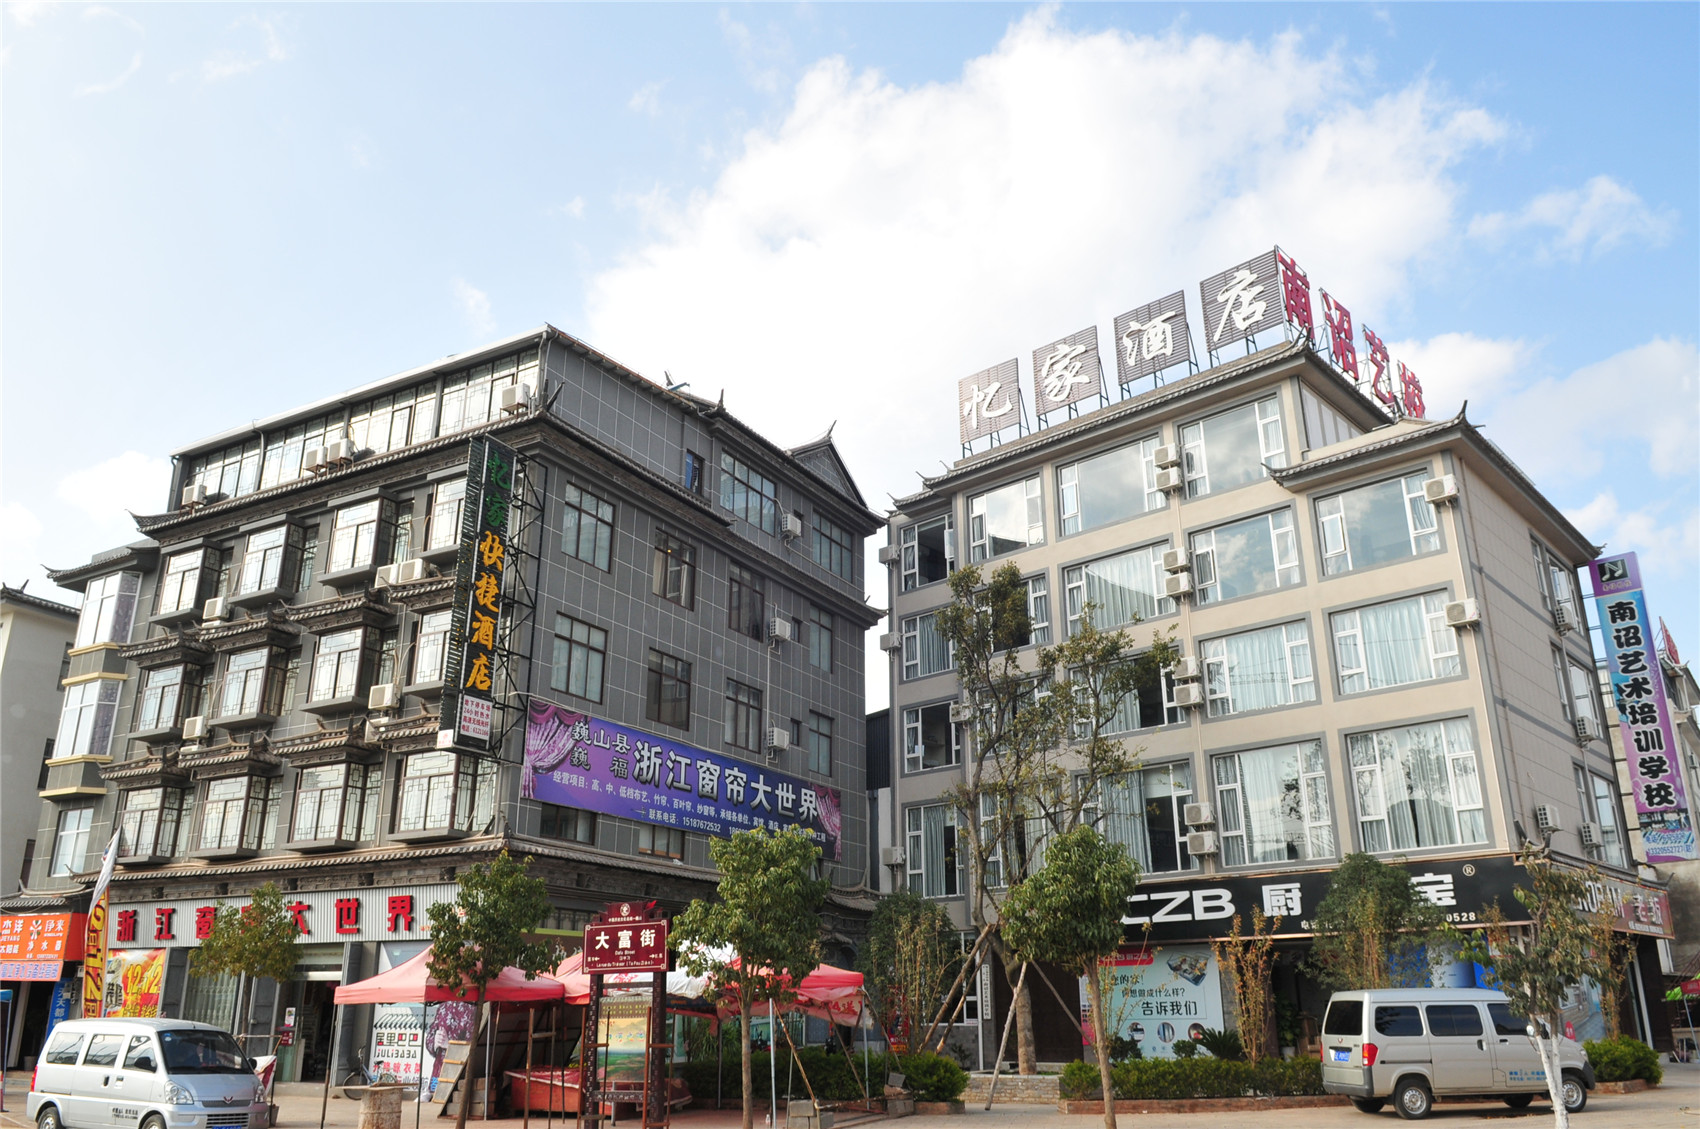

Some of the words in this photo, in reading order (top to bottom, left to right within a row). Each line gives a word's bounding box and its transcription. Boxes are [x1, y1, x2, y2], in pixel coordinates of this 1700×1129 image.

[962, 269, 1267, 429] 忆家酒店
[465, 451, 511, 690] 忆家快捷酒店
[1607, 601, 1676, 808] 南诏艺术培训学校
[571, 721, 631, 755] 巍山县
[633, 740, 818, 823] 浙江窗帘大世界
[117, 895, 414, 941] 浙江窗大世界
[595, 928, 656, 950] 大富街
[1141, 1000, 1198, 1016] 告诉我们
